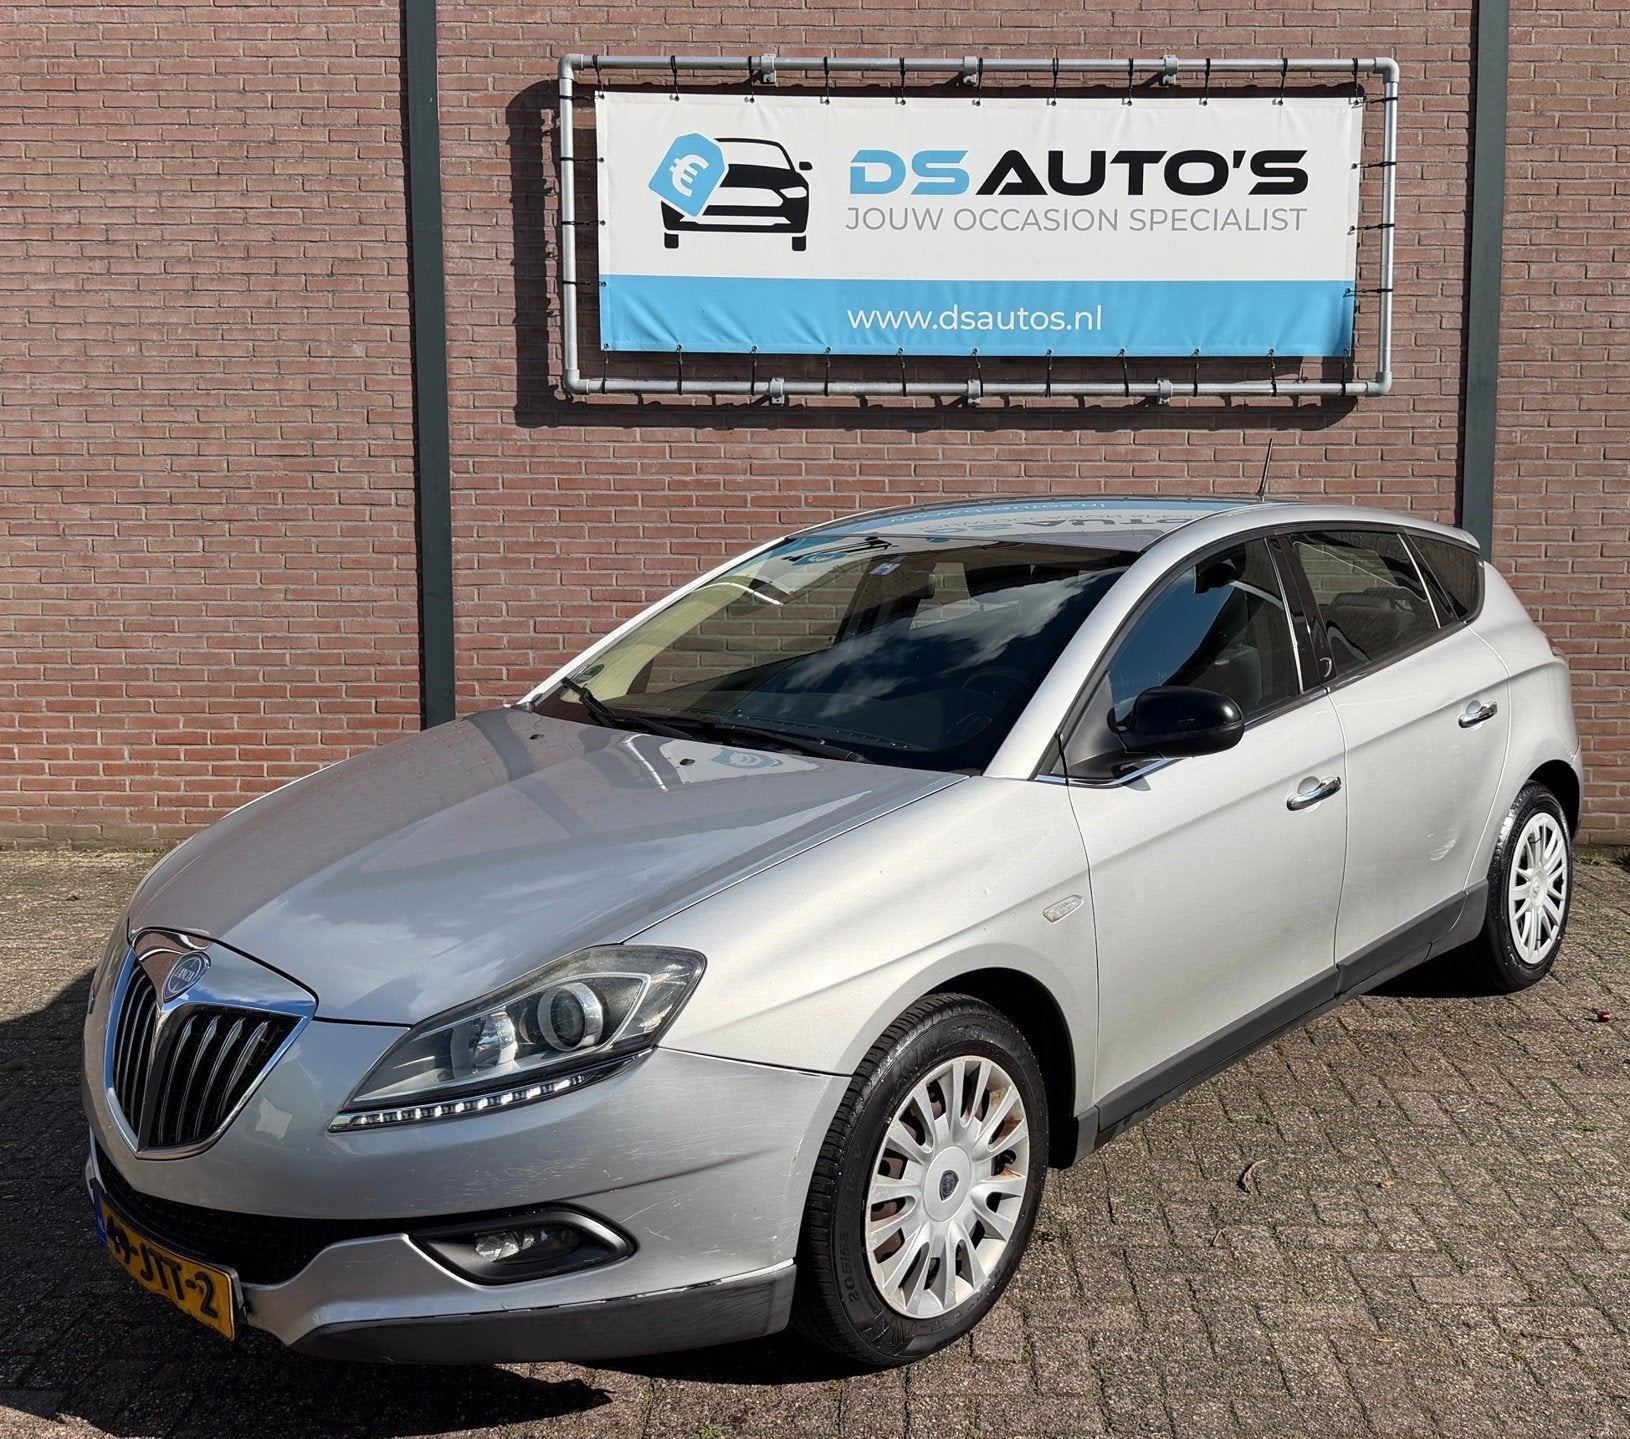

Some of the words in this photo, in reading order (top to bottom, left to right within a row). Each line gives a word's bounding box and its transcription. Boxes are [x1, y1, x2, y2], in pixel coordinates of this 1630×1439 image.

[846, 207, 944, 231] JOUW
[954, 208, 1118, 232] OCCASION
[1130, 208, 1307, 232] SPECIALIST
[847, 304, 1103, 333] www.dsautos.nl
